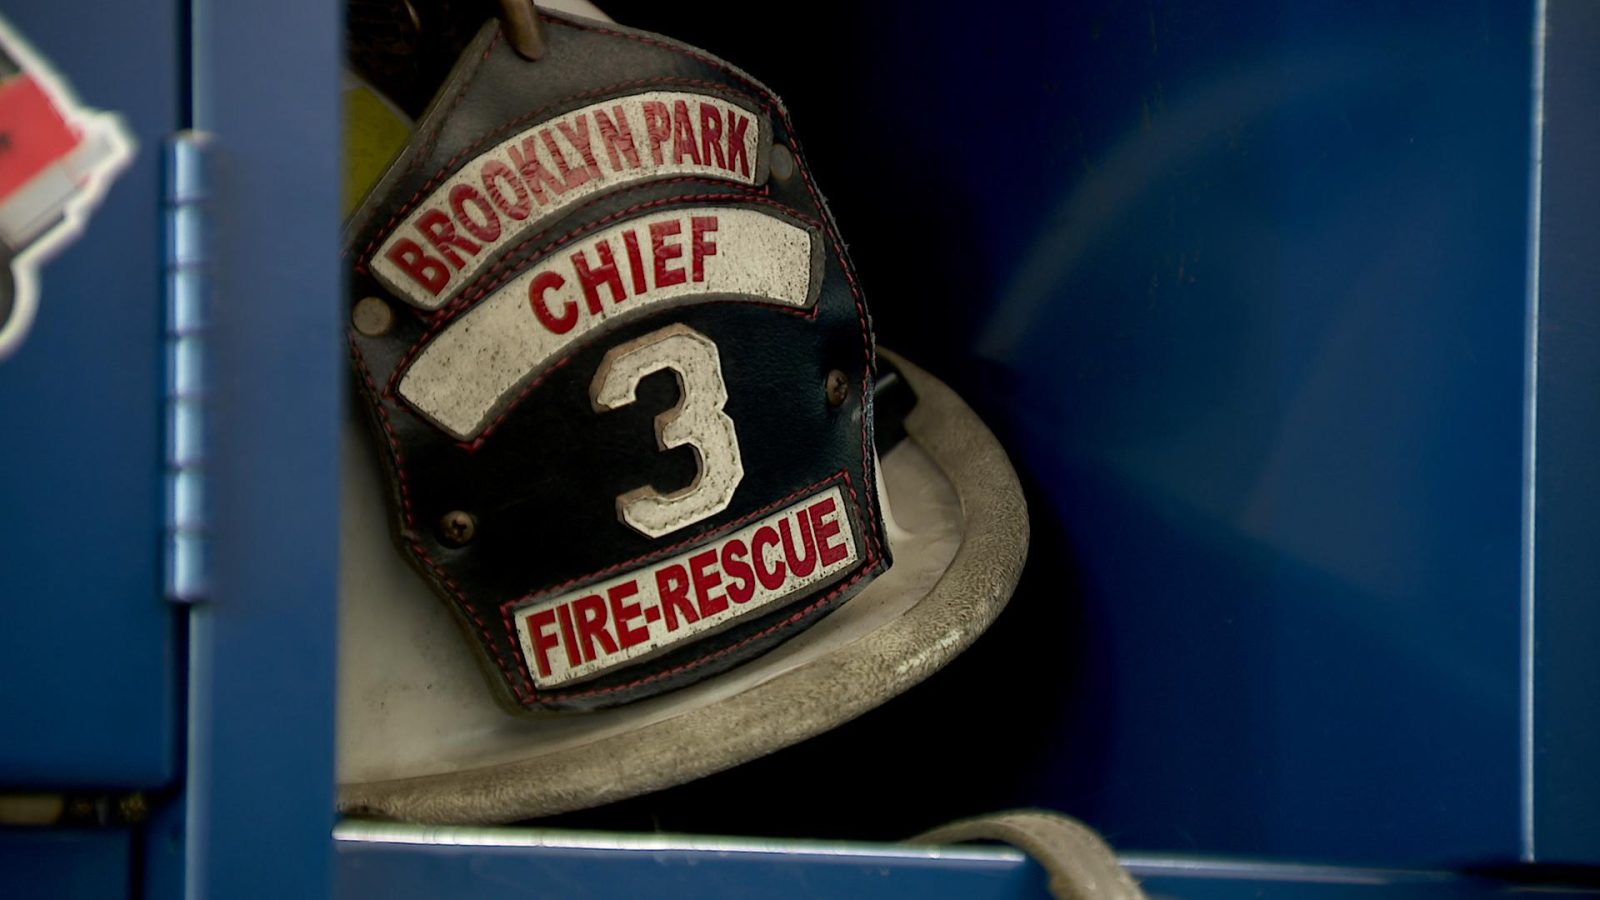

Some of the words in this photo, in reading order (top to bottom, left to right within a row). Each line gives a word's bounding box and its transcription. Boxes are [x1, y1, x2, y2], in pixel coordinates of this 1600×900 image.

[385, 104, 640, 297] BROOKLYN
[643, 99, 751, 179] PARK
[528, 216, 718, 335] CHIEF
[588, 322, 745, 539] 3
[525, 497, 849, 678] FIRE-RESCUE
